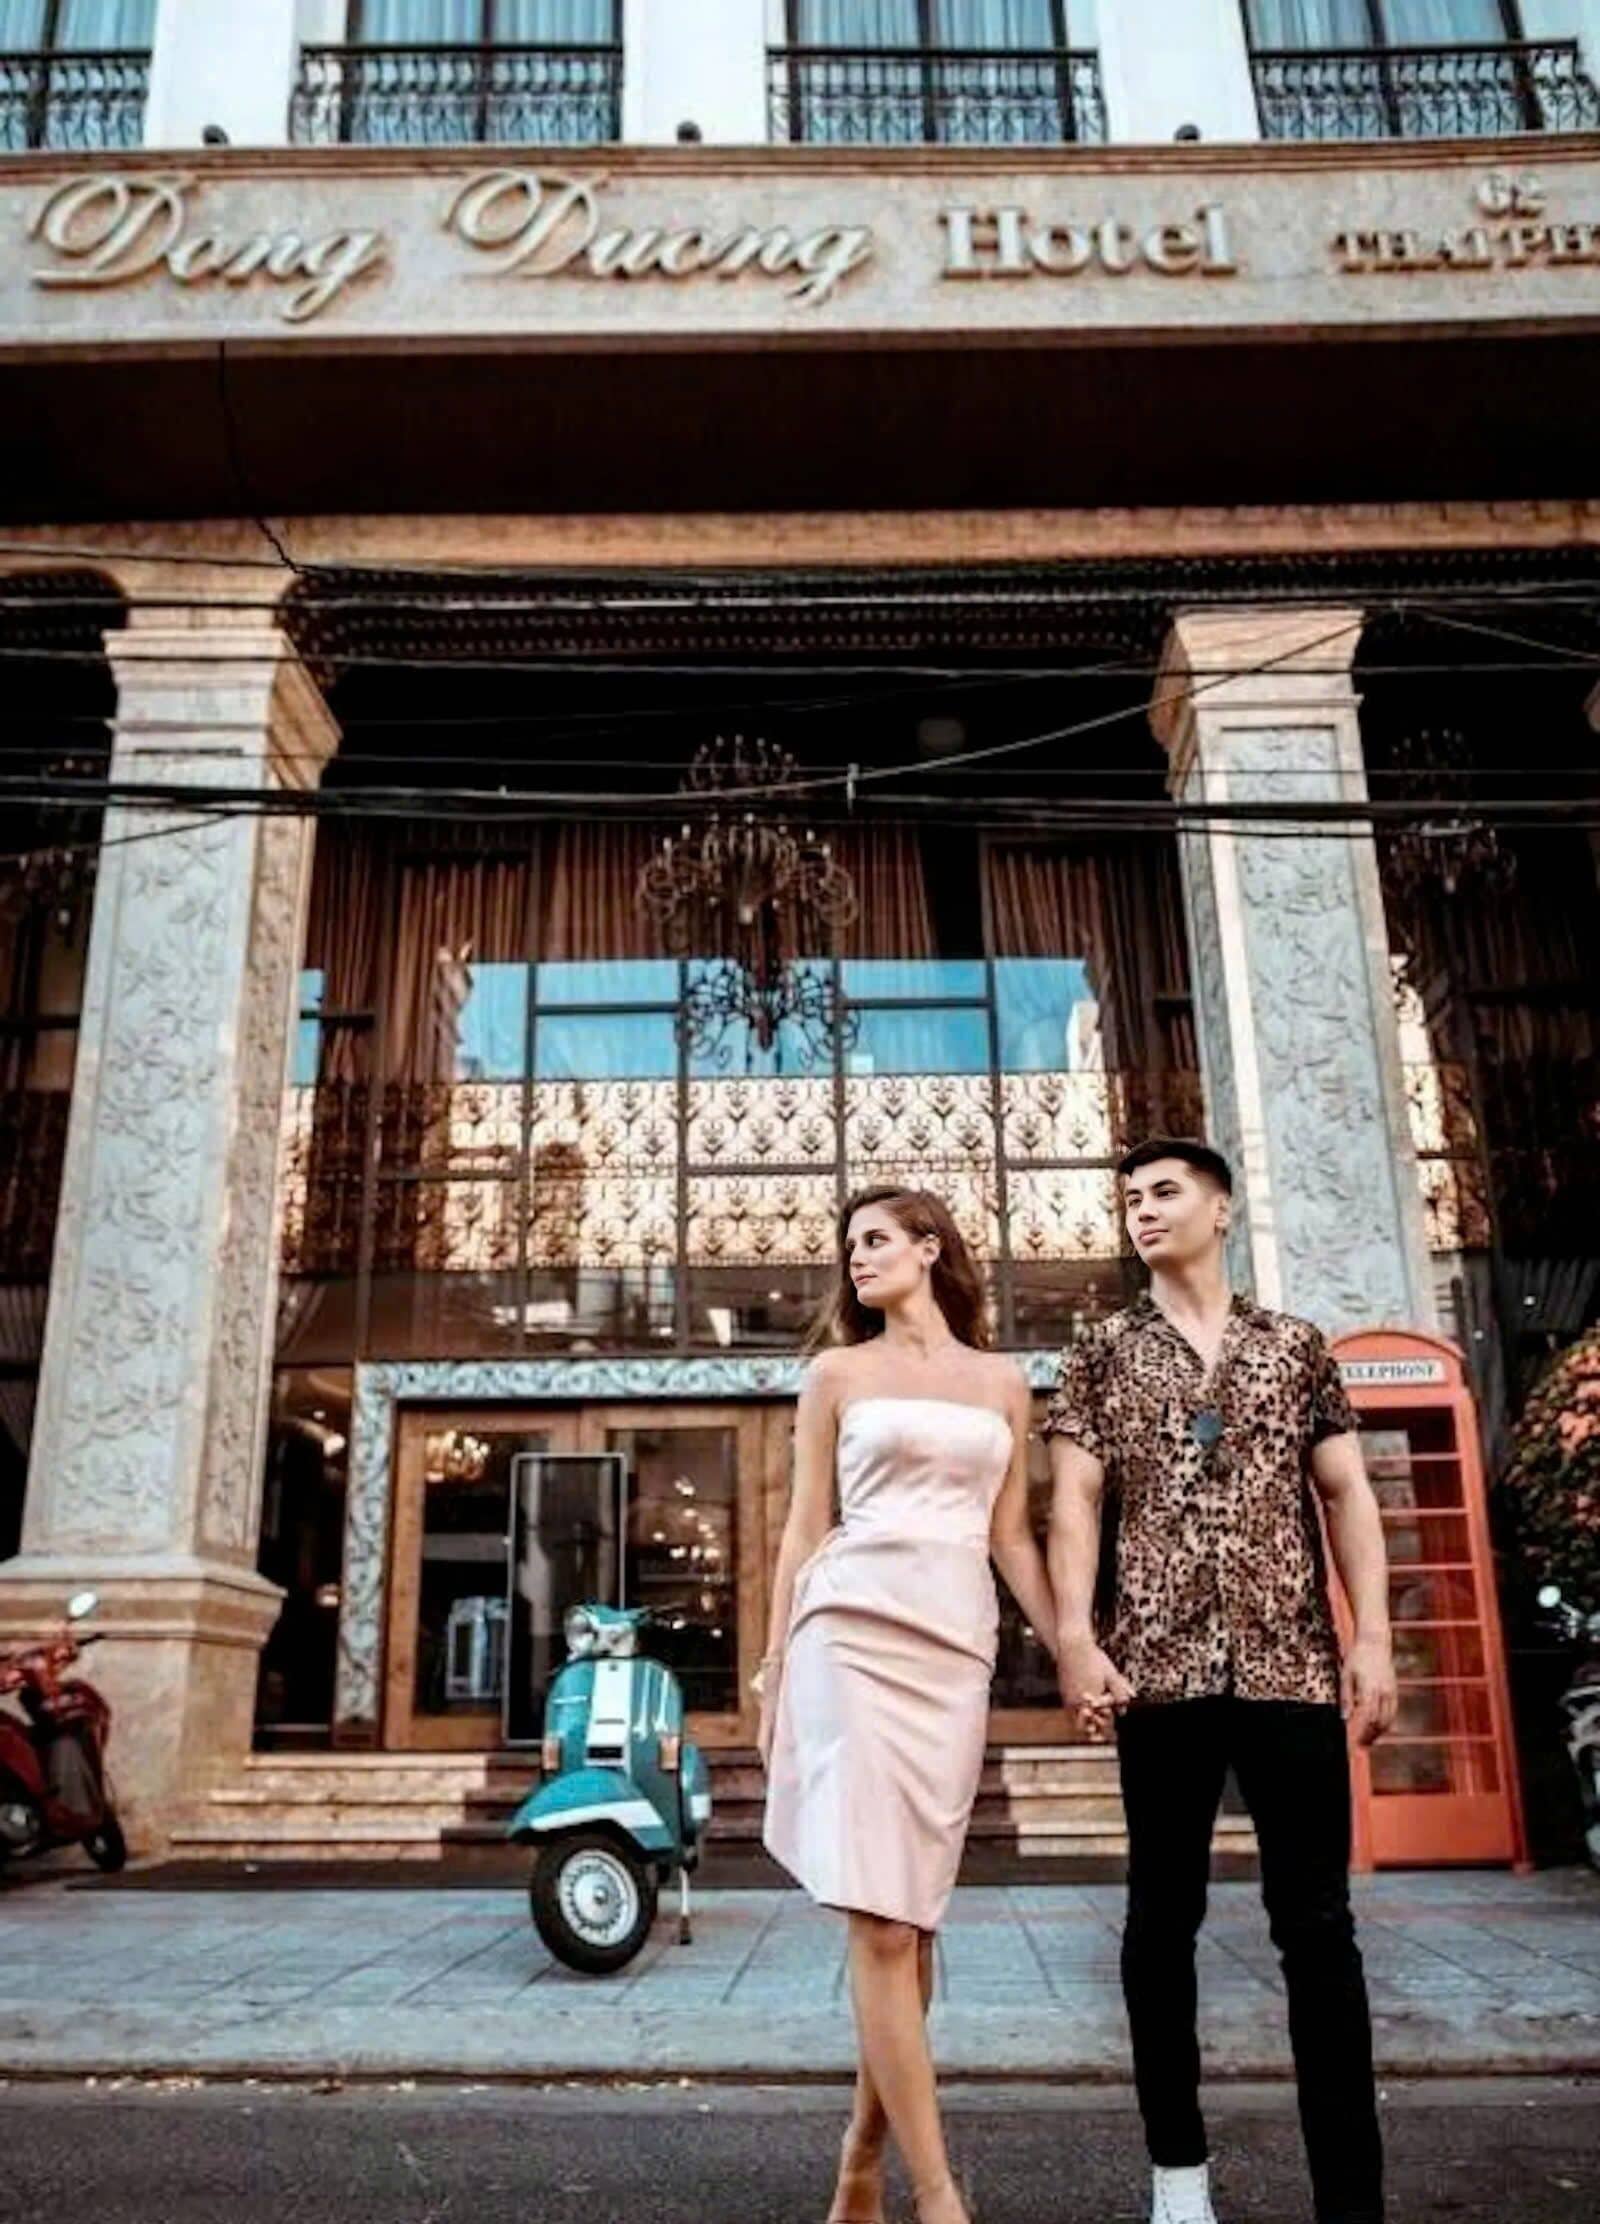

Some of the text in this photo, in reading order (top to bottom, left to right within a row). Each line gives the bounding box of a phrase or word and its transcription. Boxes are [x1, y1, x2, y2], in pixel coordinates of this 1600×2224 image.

[28, 167, 1239, 324] Dong Duong Hotel
[1501, 223, 1600, 269] PH
